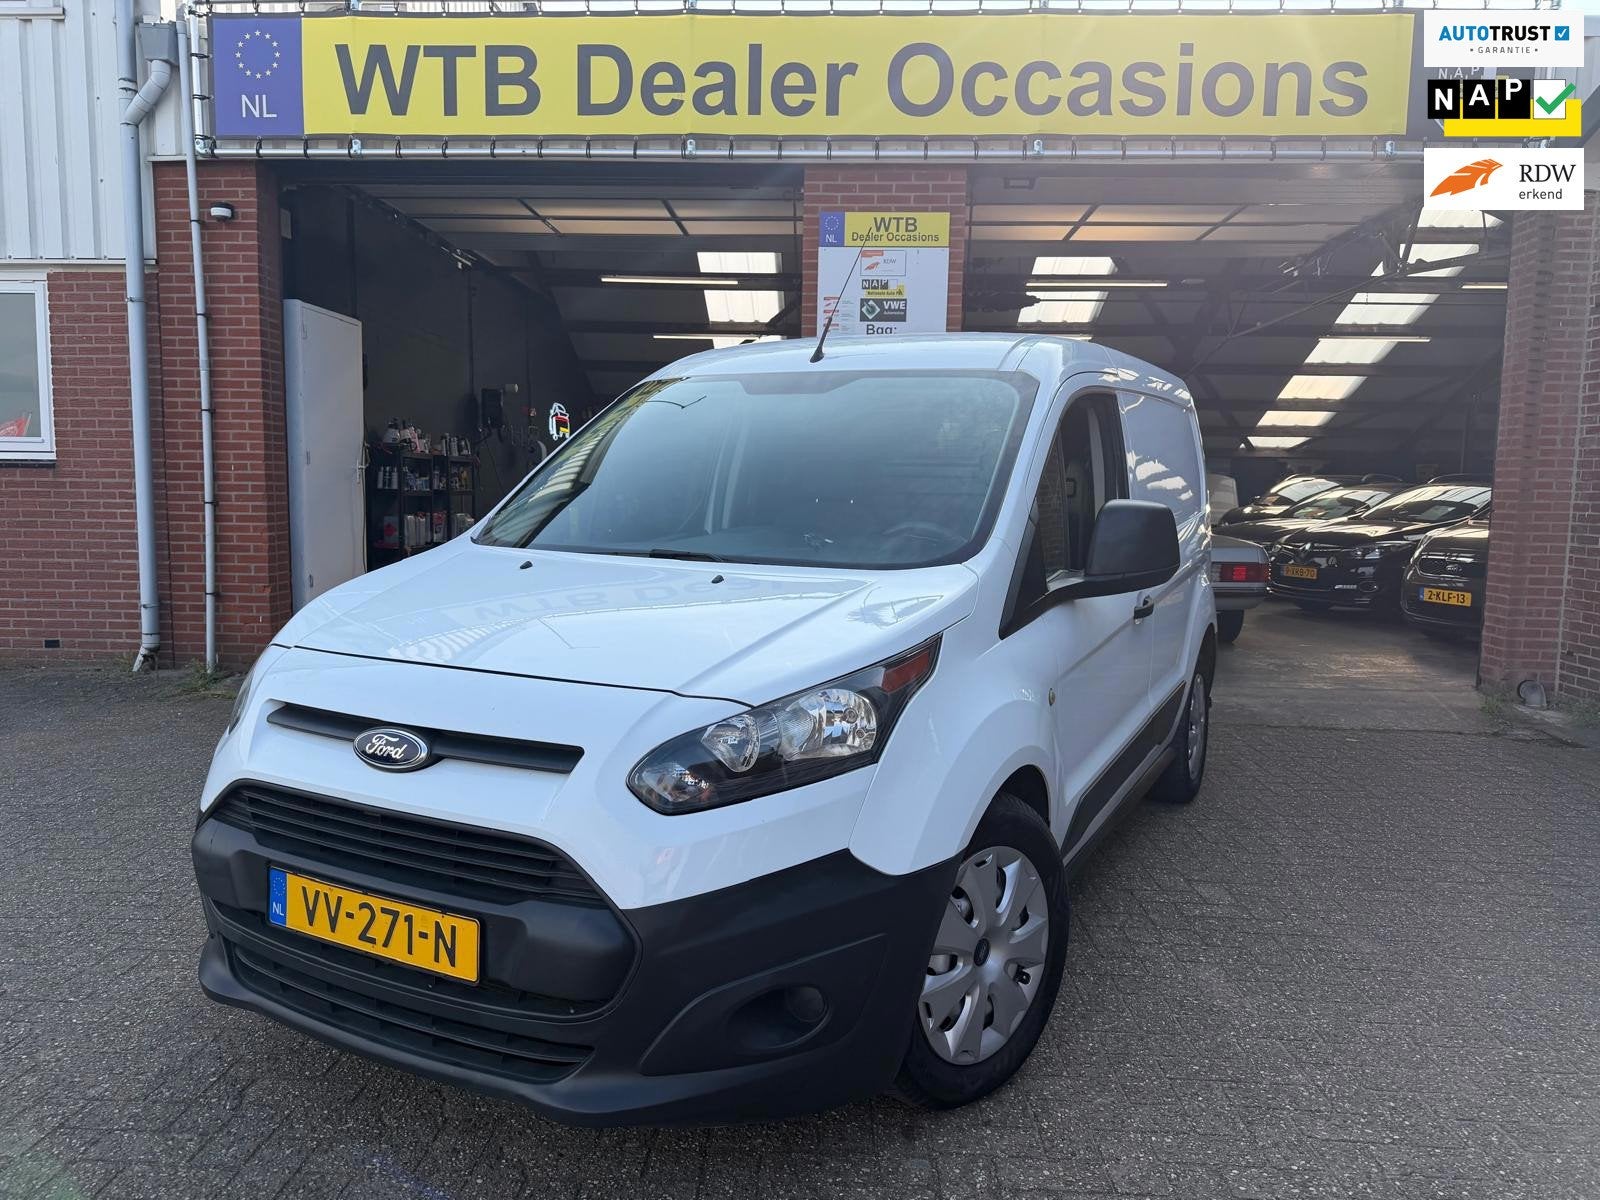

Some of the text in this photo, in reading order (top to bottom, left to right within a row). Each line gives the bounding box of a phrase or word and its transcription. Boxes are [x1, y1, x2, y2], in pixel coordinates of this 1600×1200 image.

[335, 41, 1370, 119] WTB Dealer Occasions
[241, 94, 277, 118] NL
[873, 217, 918, 232] WTB
[825, 234, 837, 243] NL
[851, 232, 940, 242] Dealer Occasions
[883, 301, 906, 310] VWE
[1427, 590, 1466, 604] 2-KLF-13
[365, 733, 404, 760] Ford
[272, 901, 285, 916] NL
[301, 885, 457, 968] VV-271-N
